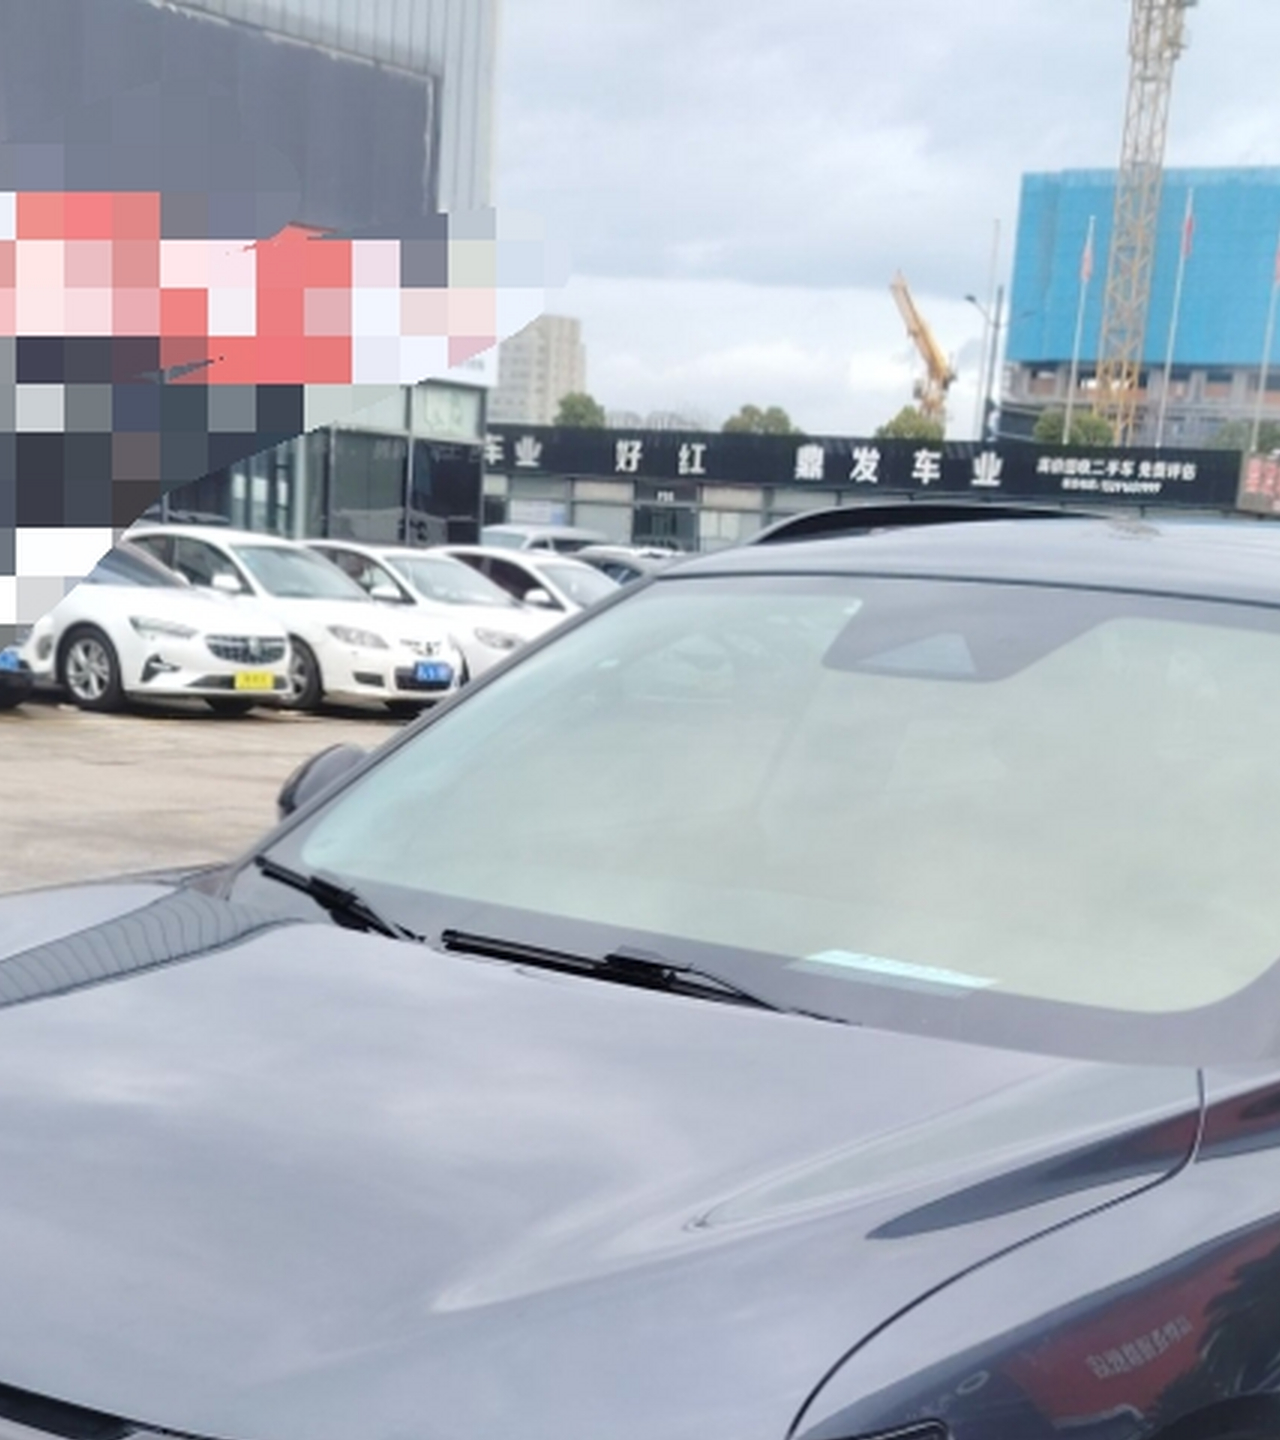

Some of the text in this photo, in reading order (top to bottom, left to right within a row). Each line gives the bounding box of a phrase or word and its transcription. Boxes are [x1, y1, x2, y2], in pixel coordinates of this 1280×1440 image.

[615, 439, 707, 475] 好红
[795, 443, 1003, 487] 鼎发车业
